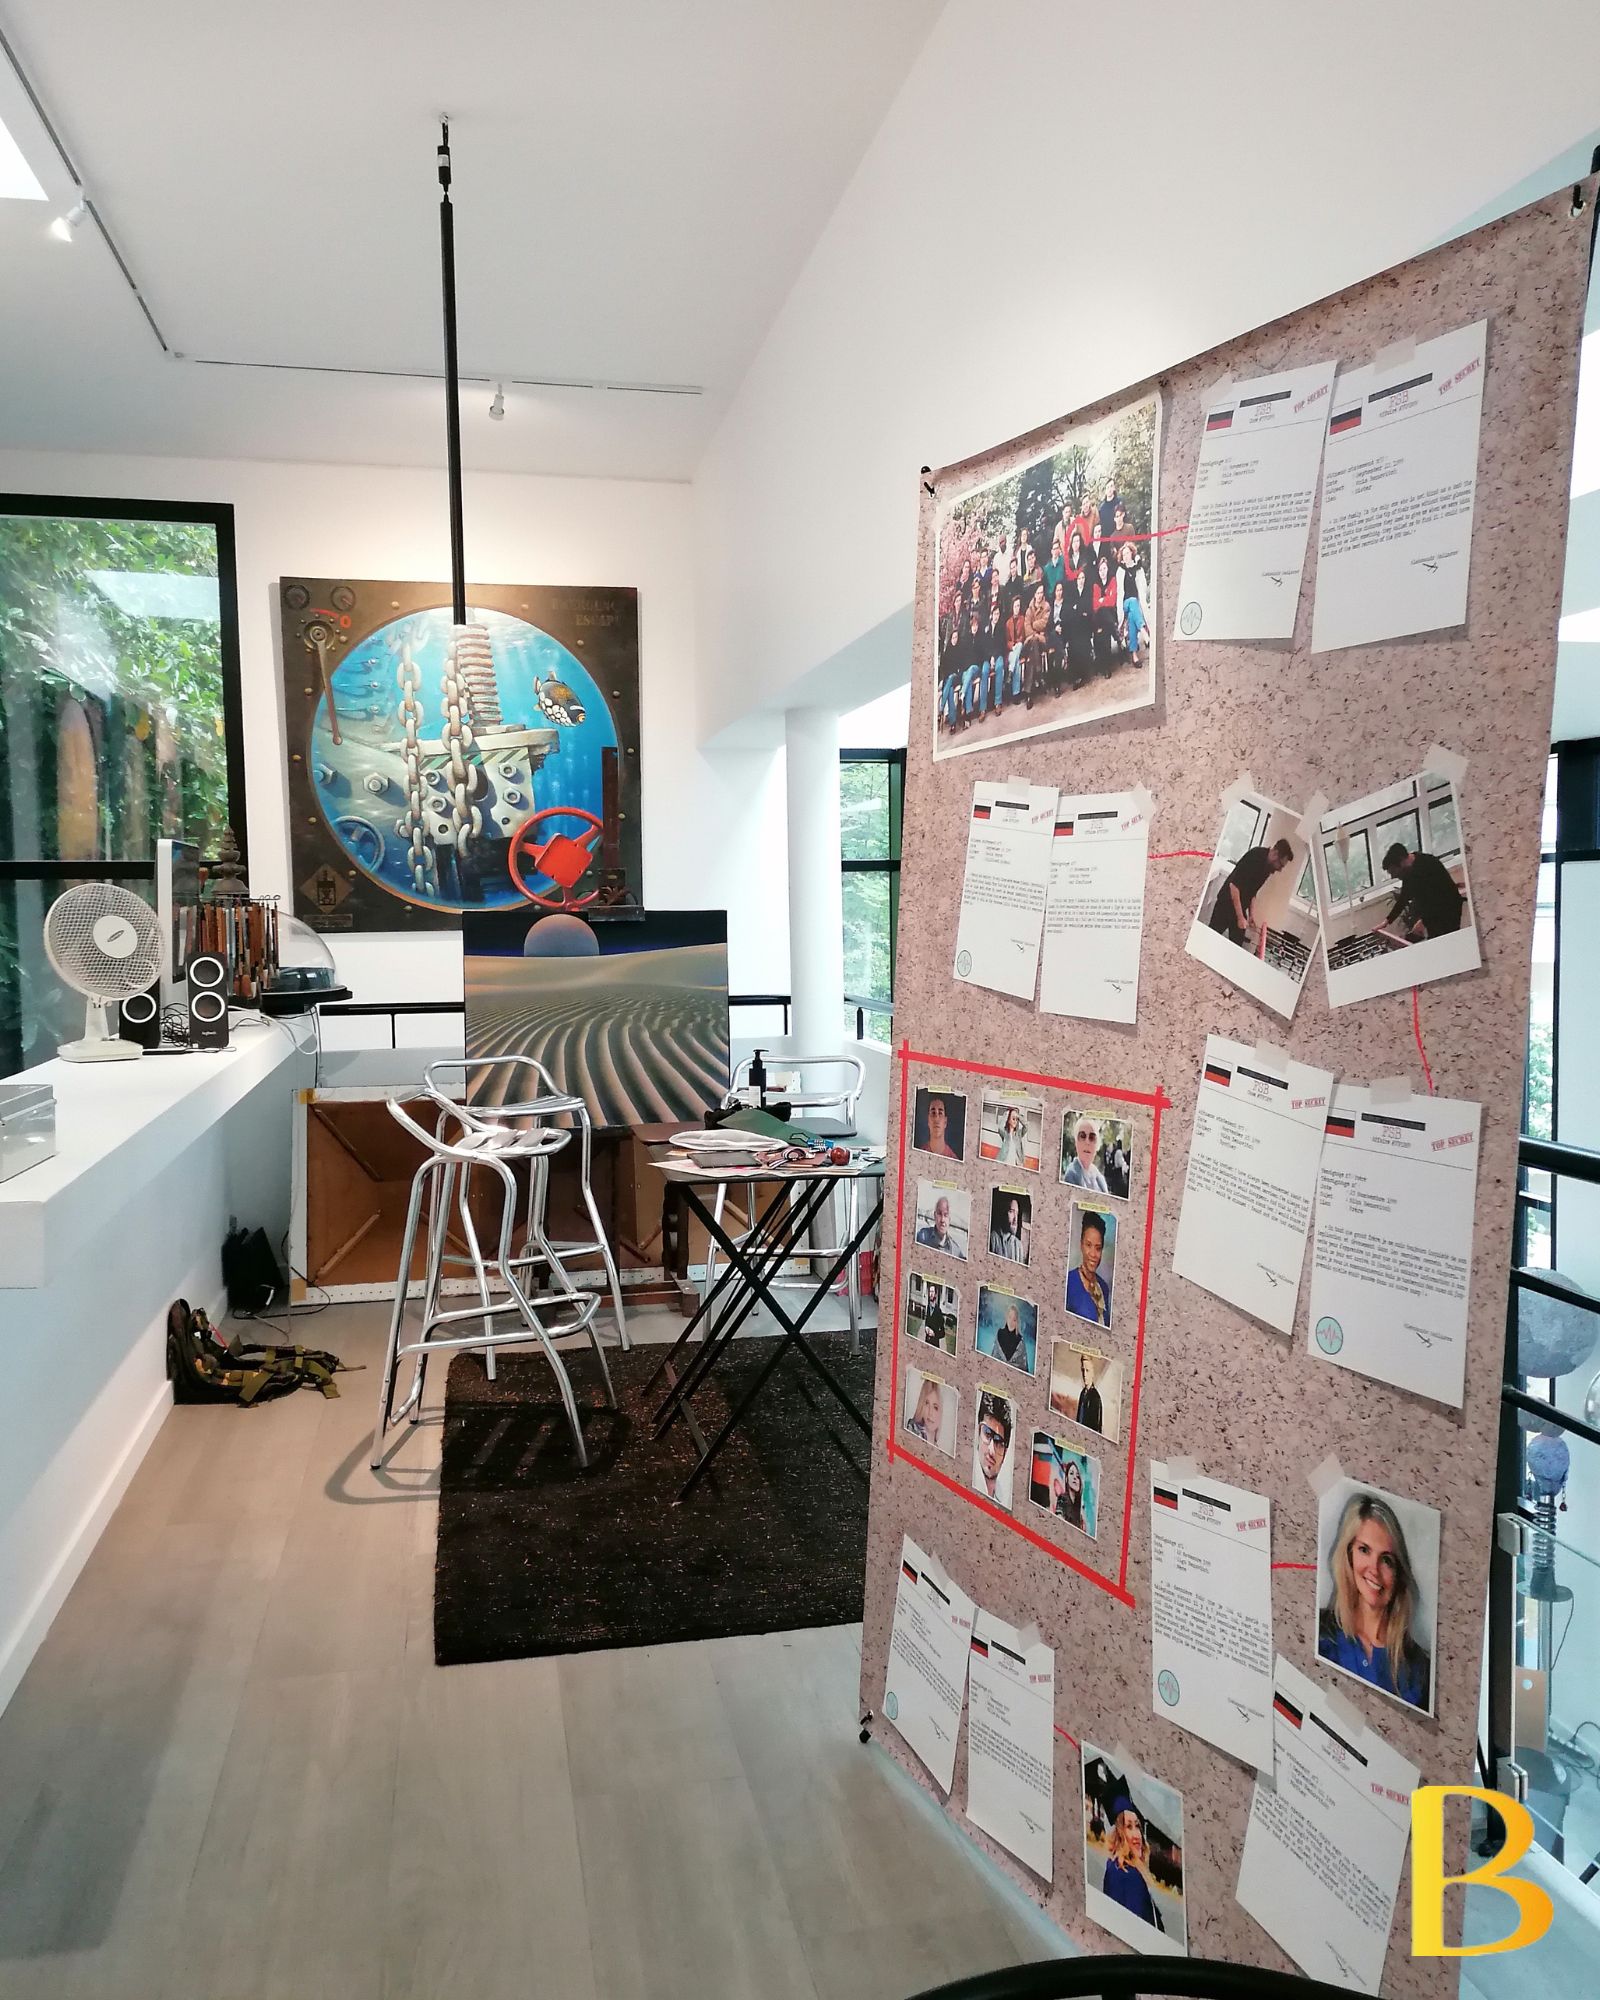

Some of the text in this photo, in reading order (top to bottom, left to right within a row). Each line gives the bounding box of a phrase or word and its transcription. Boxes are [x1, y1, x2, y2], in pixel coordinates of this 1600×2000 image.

[1438, 358, 1481, 395] TOP SECRET
[1292, 1097, 1326, 1110] TOP SECRET
[1431, 1132, 1474, 1152] TOP SECRET
[1248, 1518, 1266, 1530] SECRET
[1370, 1782, 1409, 1806] TOP SECRET
